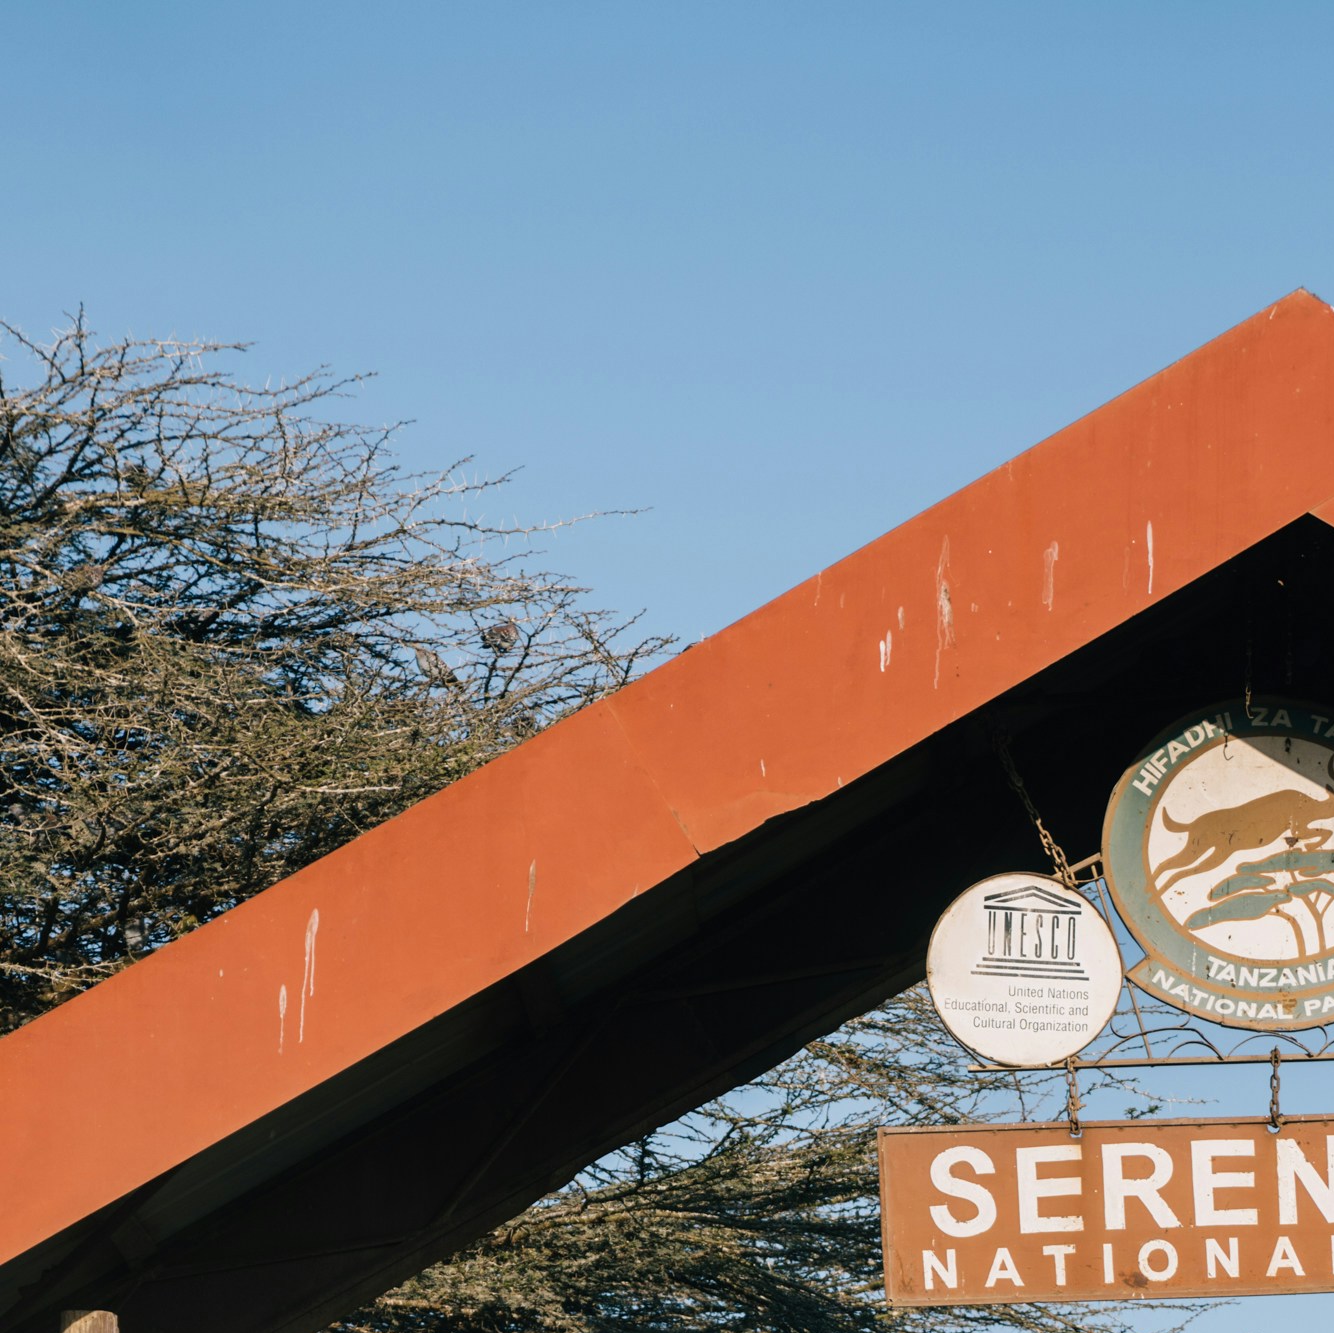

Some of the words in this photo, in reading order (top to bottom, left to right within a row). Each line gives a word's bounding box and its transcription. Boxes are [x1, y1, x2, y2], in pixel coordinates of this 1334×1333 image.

[1132, 711, 1233, 796] HIFADHI
[1251, 707, 1292, 729] ZA
[987, 910, 1076, 960] UNESCO
[944, 997, 1011, 1014] Educational,
[1014, 1002, 1065, 1016] Scientific
[1068, 1004, 1089, 1016] and
[1008, 984, 1044, 998] United
[1047, 986, 1089, 1000] Nations
[1151, 969, 1294, 1020] NATIONAL
[973, 1016, 1016, 1029] Cultural
[1019, 1018, 1089, 1033] Organization
